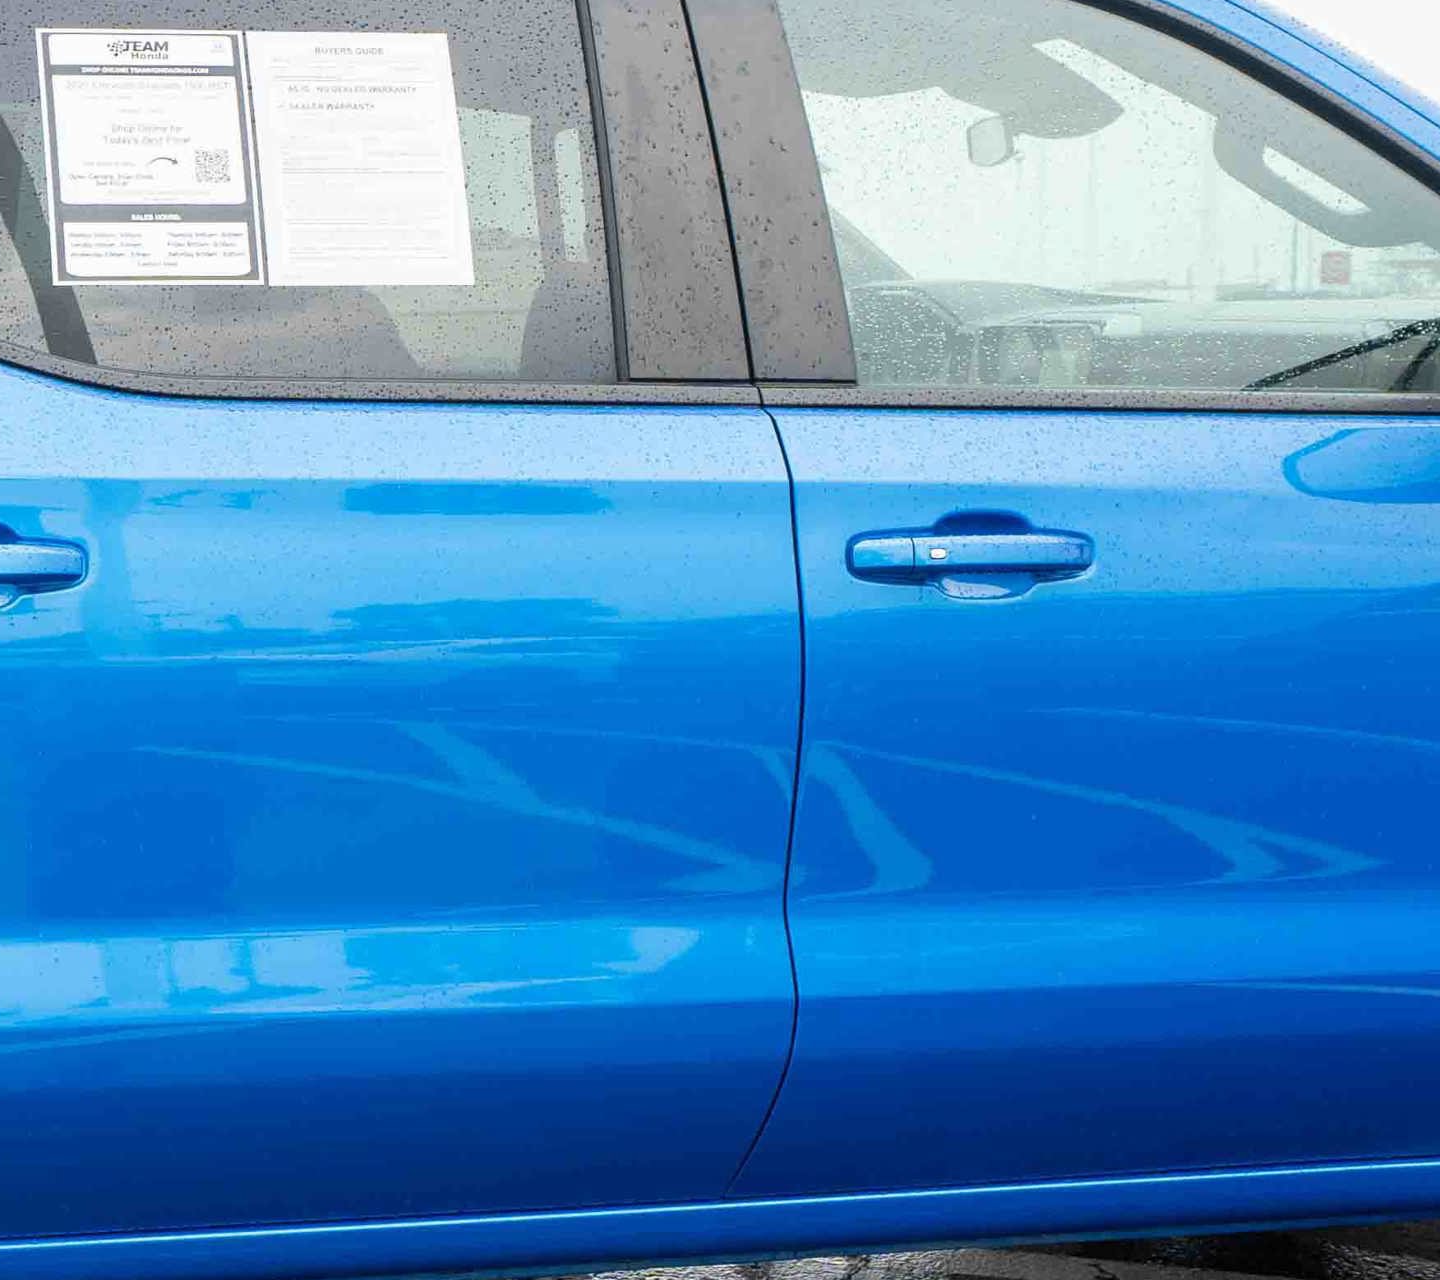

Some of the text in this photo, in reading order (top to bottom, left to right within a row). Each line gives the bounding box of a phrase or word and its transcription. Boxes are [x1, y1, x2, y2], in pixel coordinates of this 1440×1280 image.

[123, 40, 169, 52] TEAM
[130, 52, 169, 60] Honda
[314, 47, 385, 56] BUYERS GUIDE
